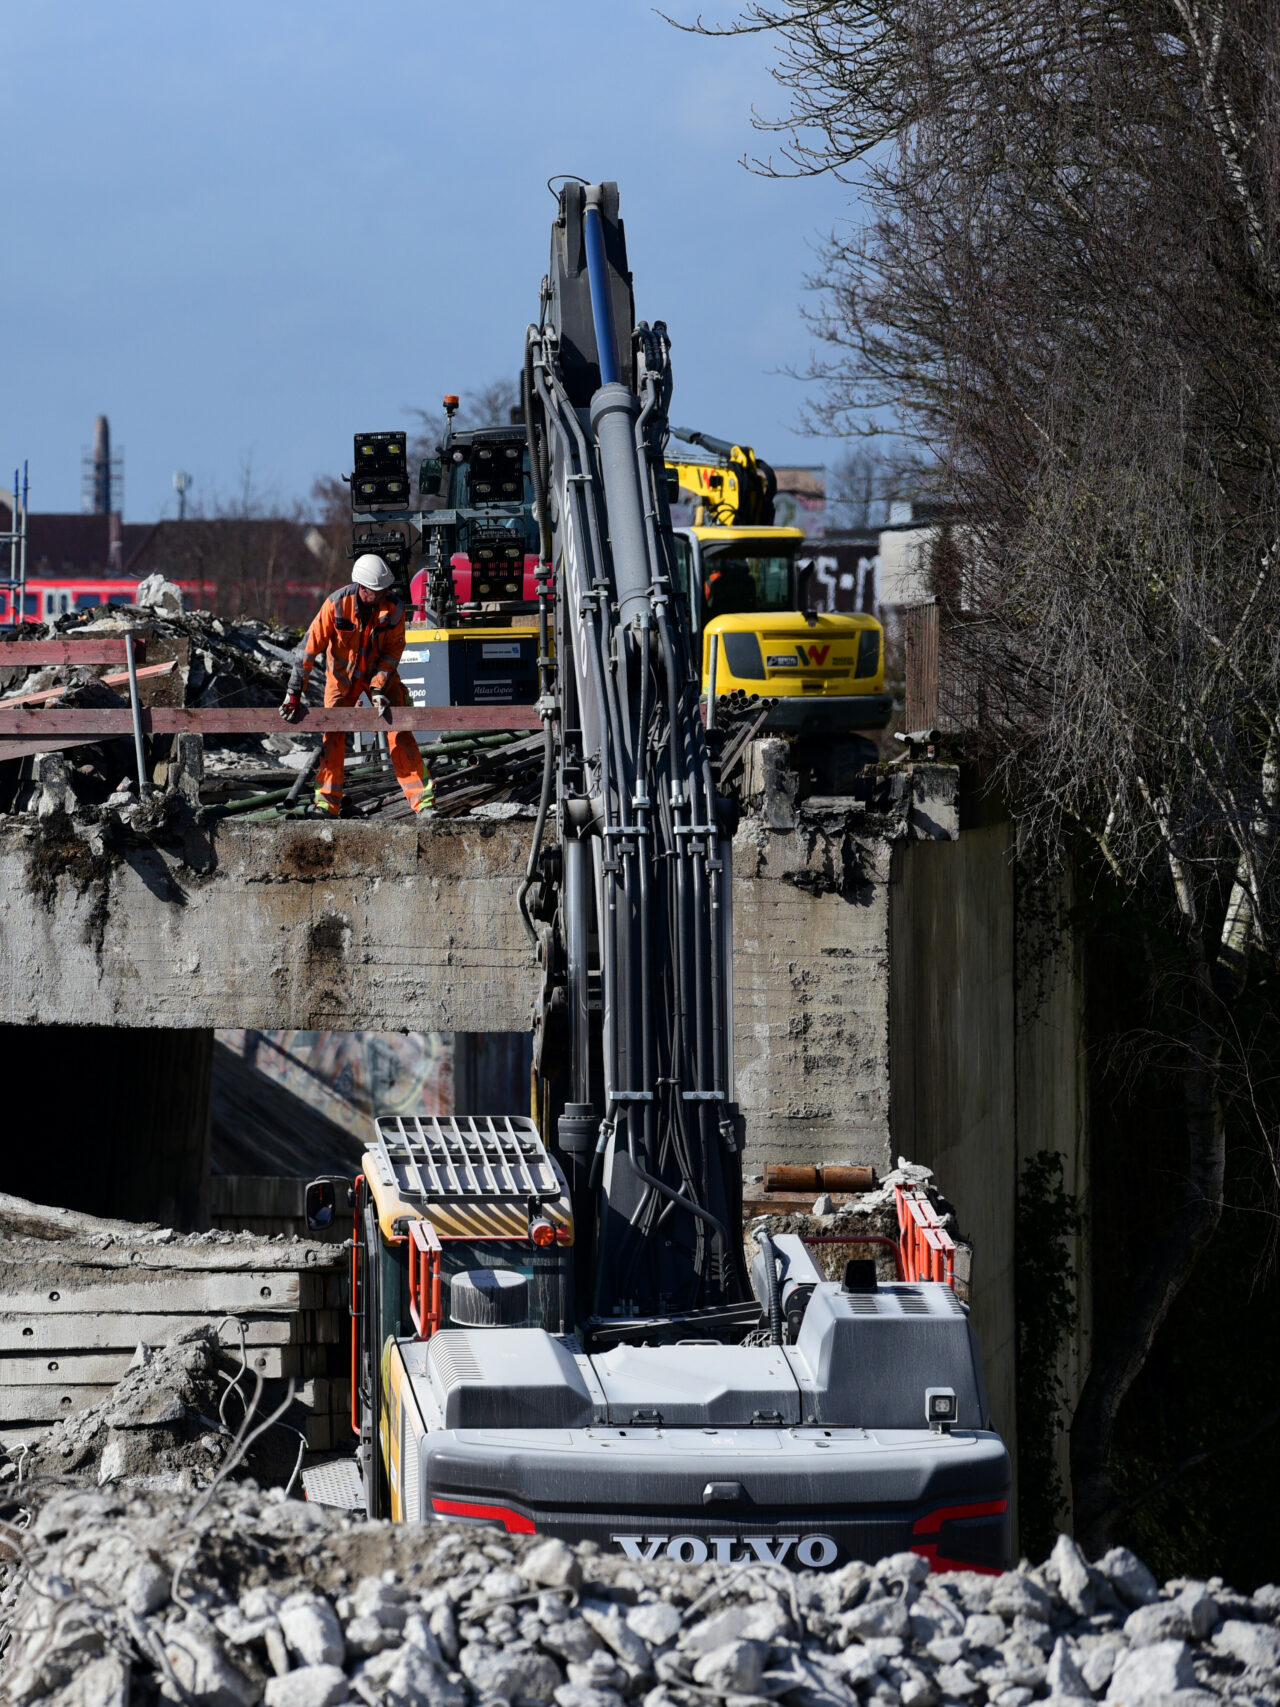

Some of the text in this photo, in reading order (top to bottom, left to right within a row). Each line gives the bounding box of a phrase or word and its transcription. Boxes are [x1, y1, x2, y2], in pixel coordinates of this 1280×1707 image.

[407, 687, 427, 699] opco
[473, 685, 514, 696] Atlas Copco
[610, 1534, 839, 1567] VOLVO
